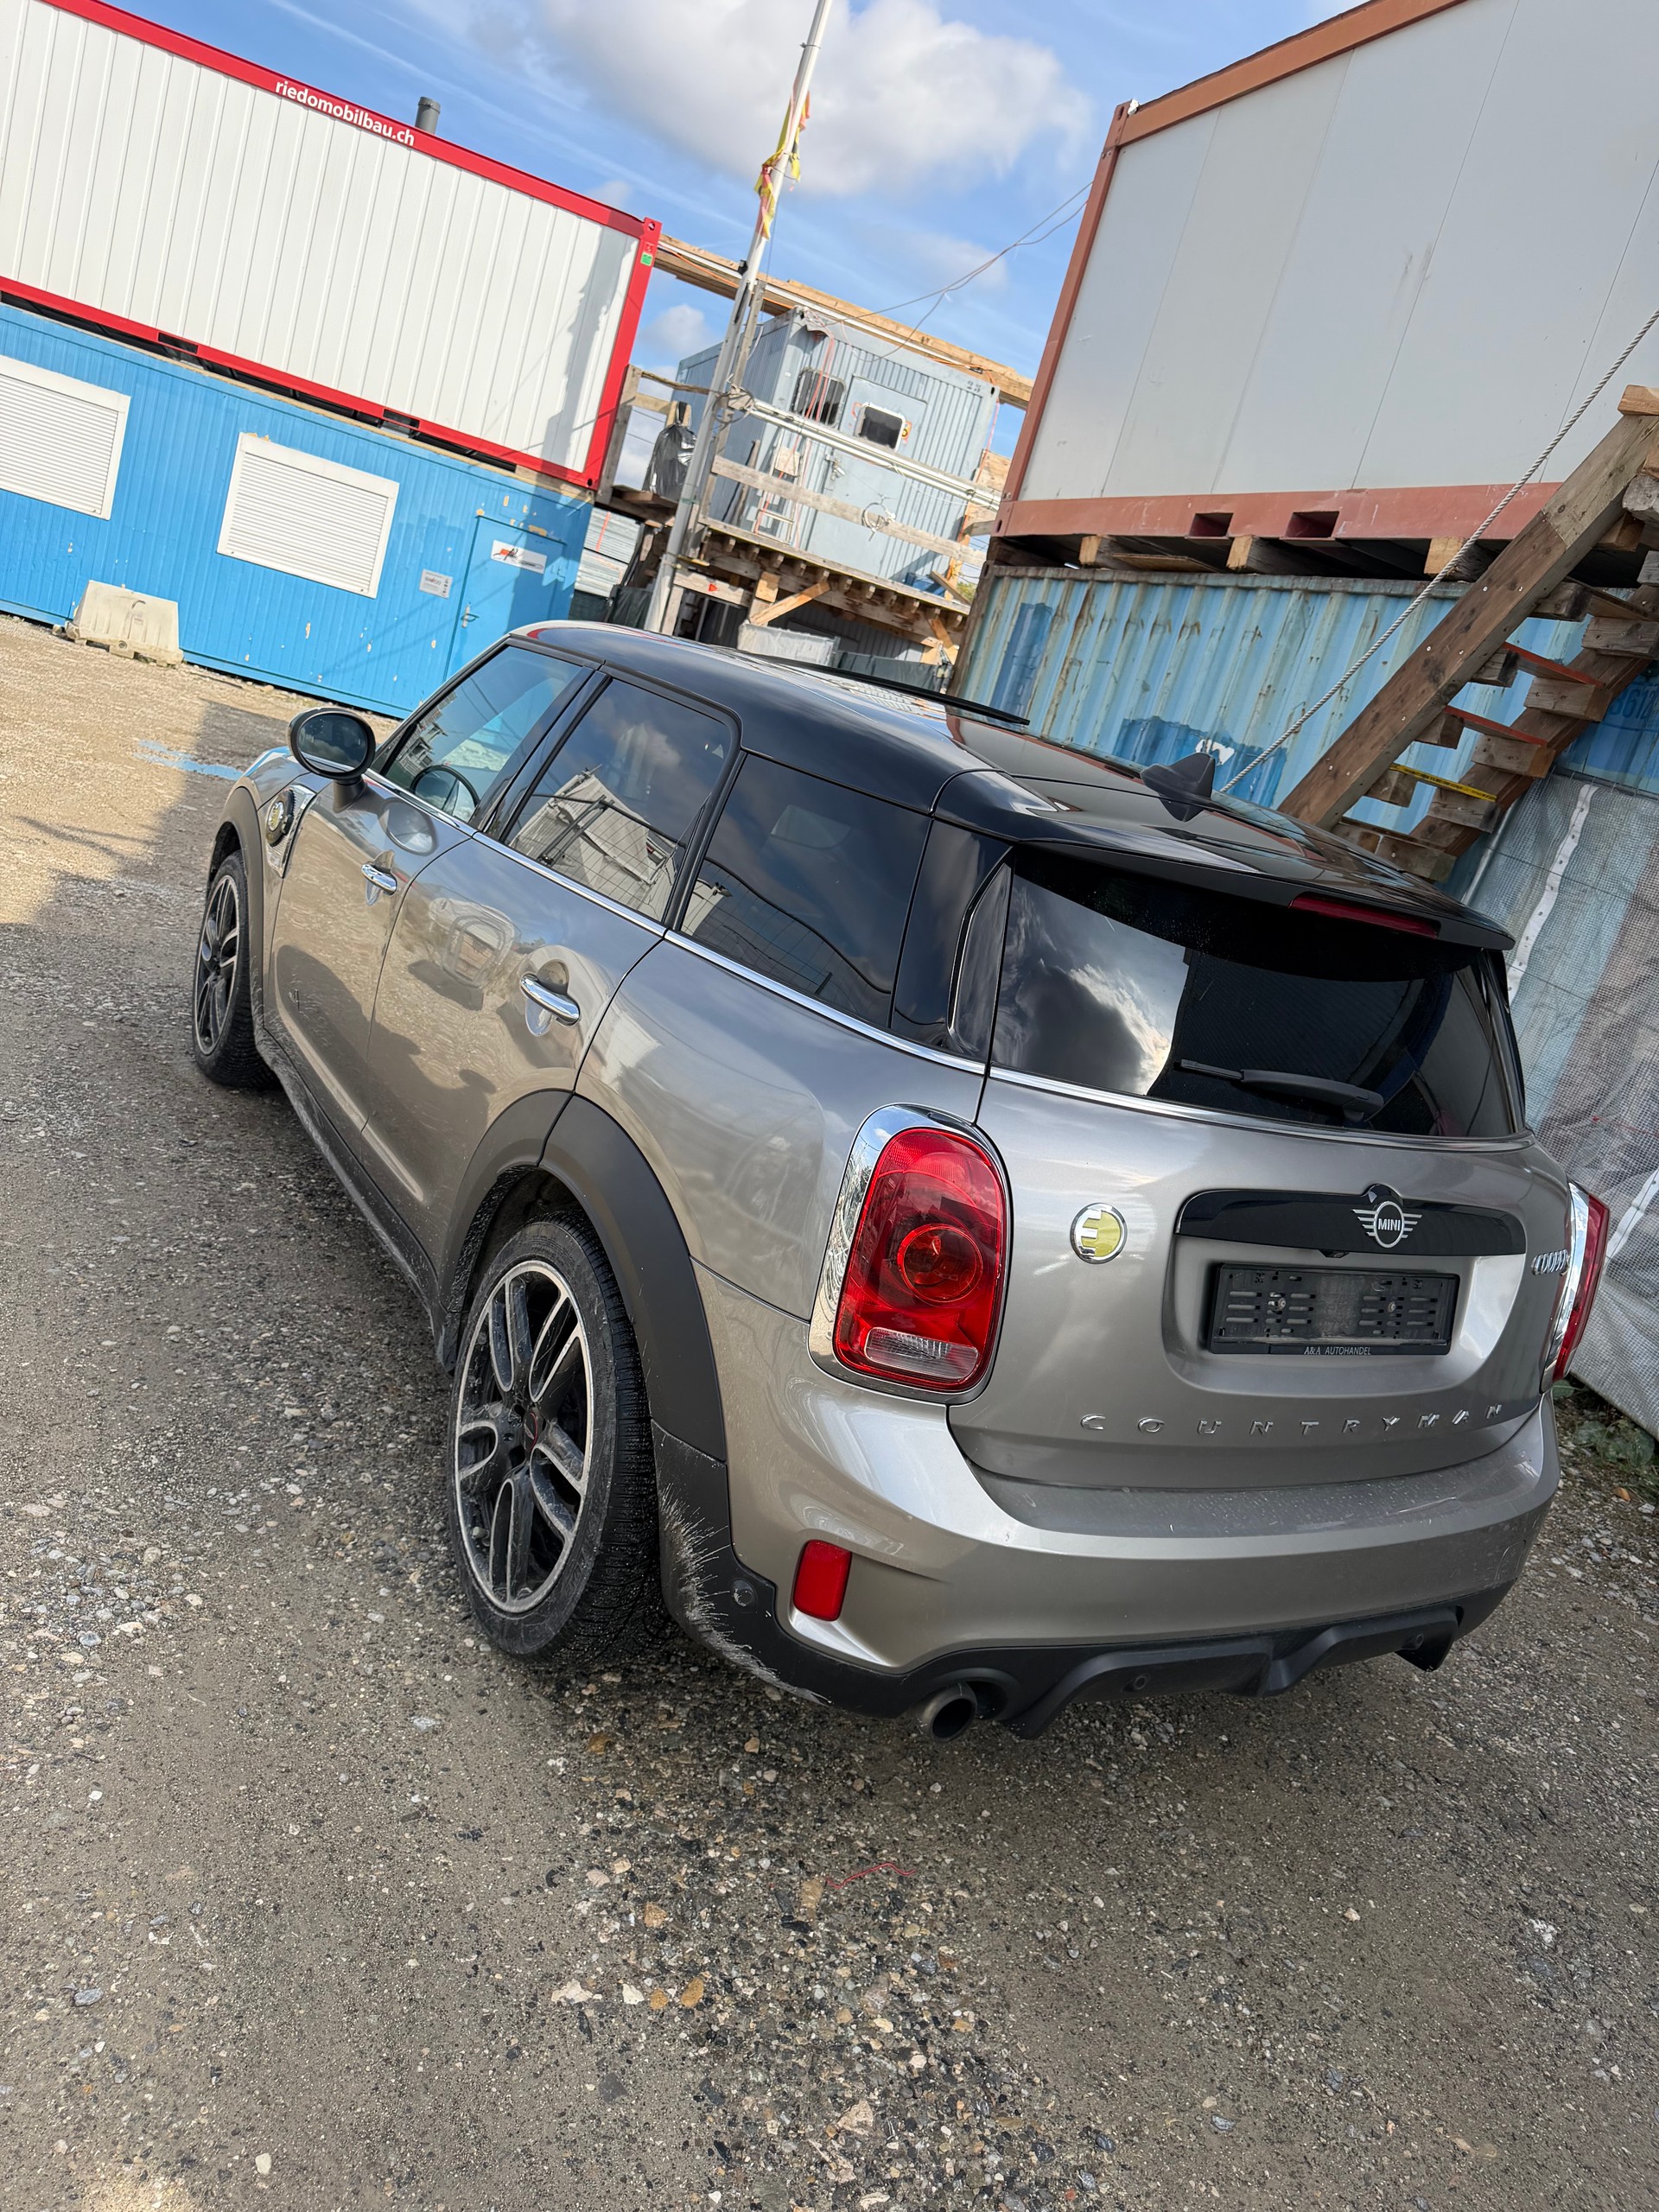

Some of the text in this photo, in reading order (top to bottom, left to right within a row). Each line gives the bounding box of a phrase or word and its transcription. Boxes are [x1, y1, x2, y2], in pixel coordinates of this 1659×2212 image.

[275, 80, 415, 147] riedomobilbau.ch
[1377, 1217, 1401, 1231] MINI
[1304, 1346, 1371, 1356] A&A AUTOHANDEL
[1080, 1403, 1503, 1436] COUNTRYMAN
